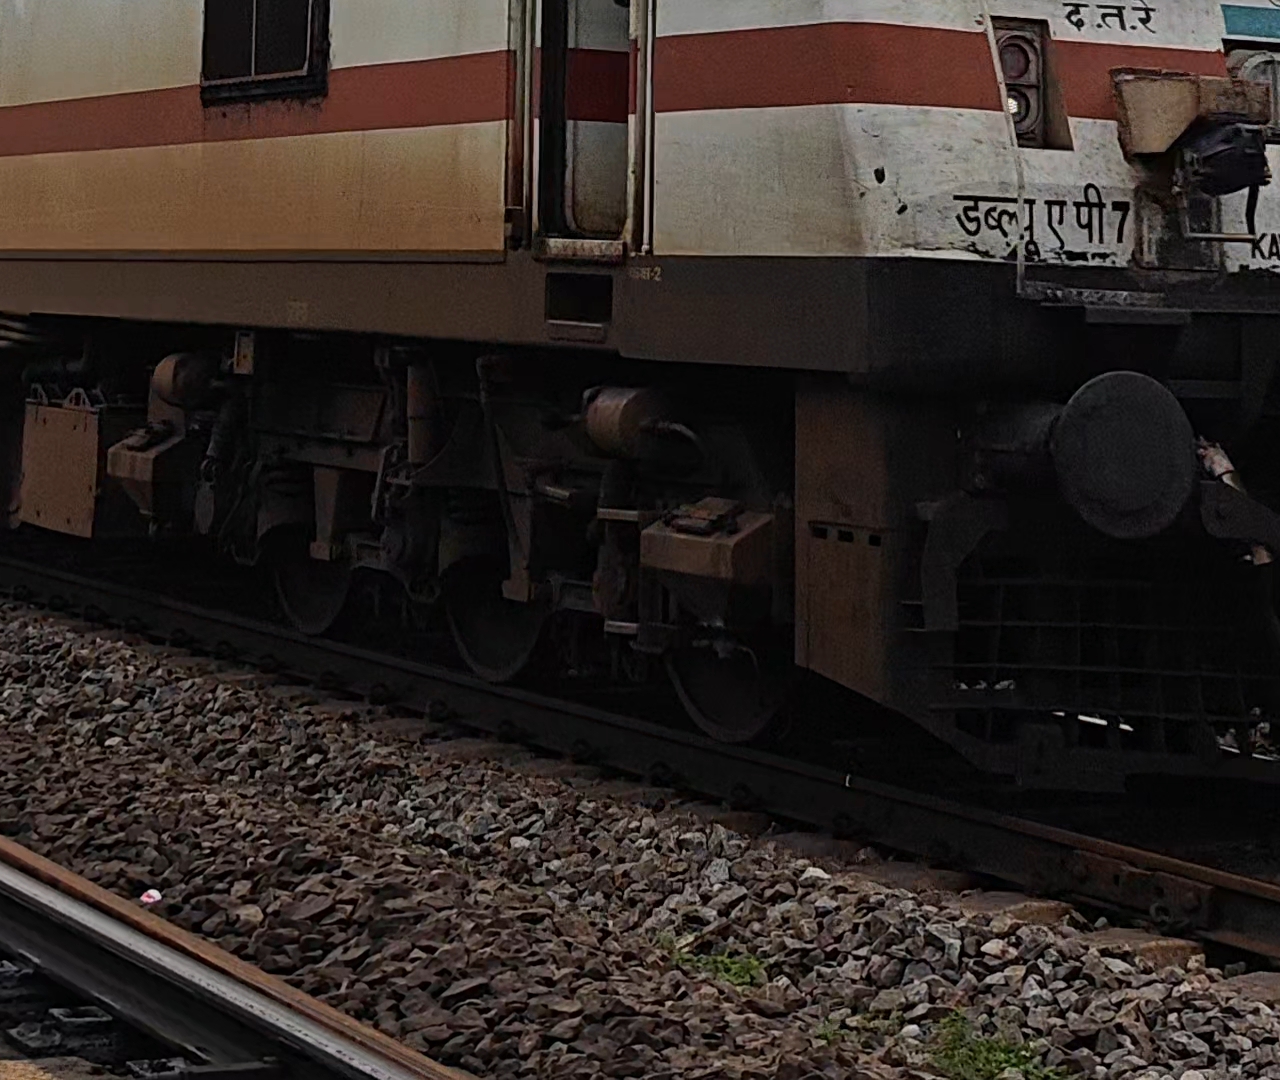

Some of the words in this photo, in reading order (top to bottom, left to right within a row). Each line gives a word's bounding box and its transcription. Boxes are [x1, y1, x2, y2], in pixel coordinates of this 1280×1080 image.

[1043, 199, 1068, 251] ए
[1072, 182, 1107, 244] पी
[1111, 200, 1131, 244] 7
